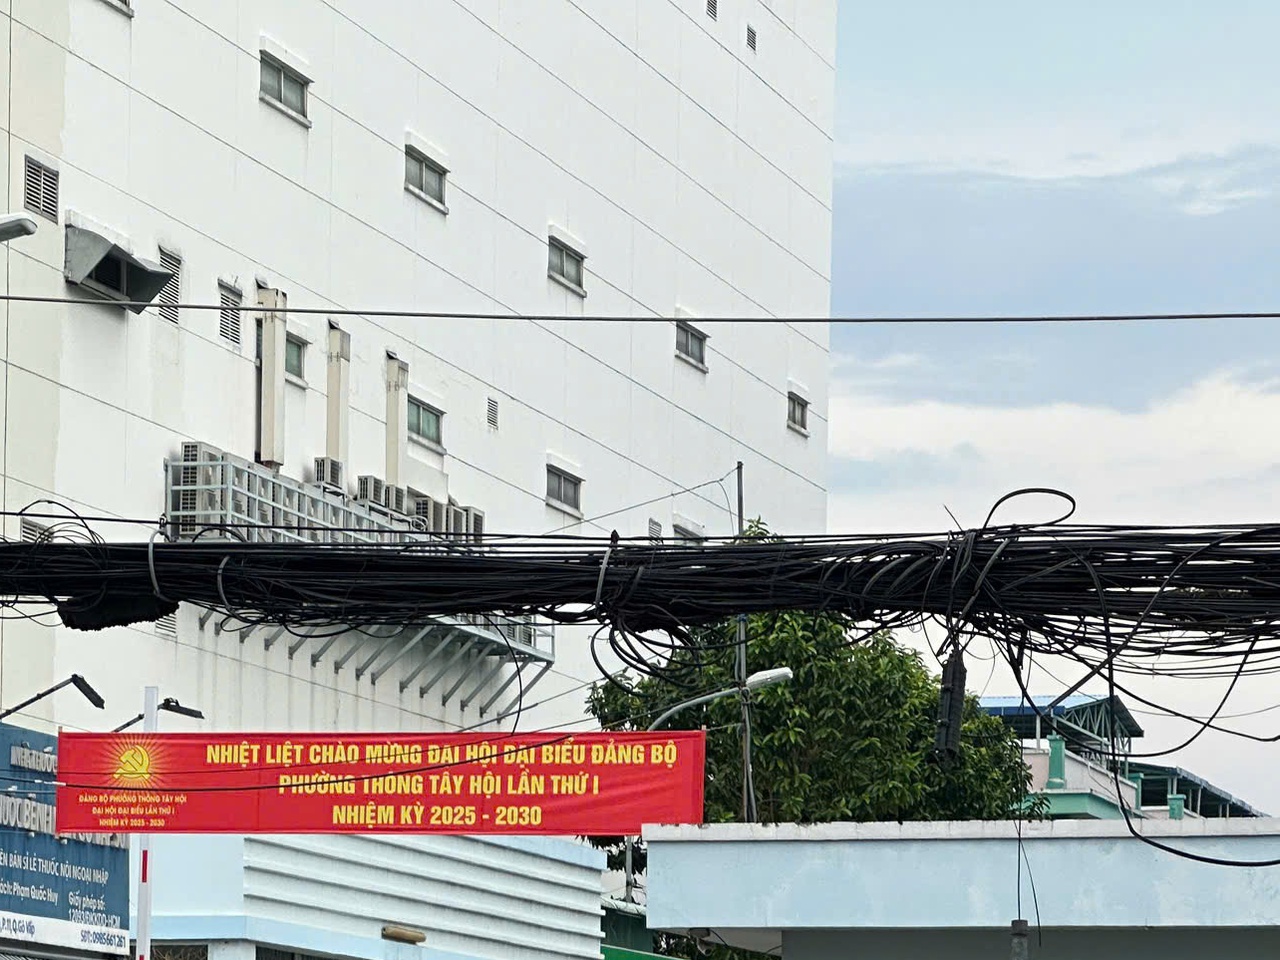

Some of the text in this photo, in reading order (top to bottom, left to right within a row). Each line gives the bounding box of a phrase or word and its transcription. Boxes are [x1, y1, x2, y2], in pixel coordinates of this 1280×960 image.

[207, 741, 260, 767] NHIỆT
[266, 741, 304, 767] LIỆT
[309, 741, 359, 764] CHÀO
[365, 742, 422, 764] MỪNG
[466, 741, 497, 768] HỘI
[503, 745, 535, 768] ĐẠI
[541, 737, 585, 764] BIỂU
[591, 739, 645, 764] ĐẢNG
[651, 741, 677, 768] BỘ
[278, 771, 356, 794] PHƯỜNG
[429, 771, 463, 794] TÂY
[470, 771, 501, 798] HỘI
[507, 769, 545, 794] LẦN
[551, 771, 588, 794] THỨ
[593, 776, 599, 794] I
[332, 801, 542, 828] NHIỆM KỲ 2025 2030
